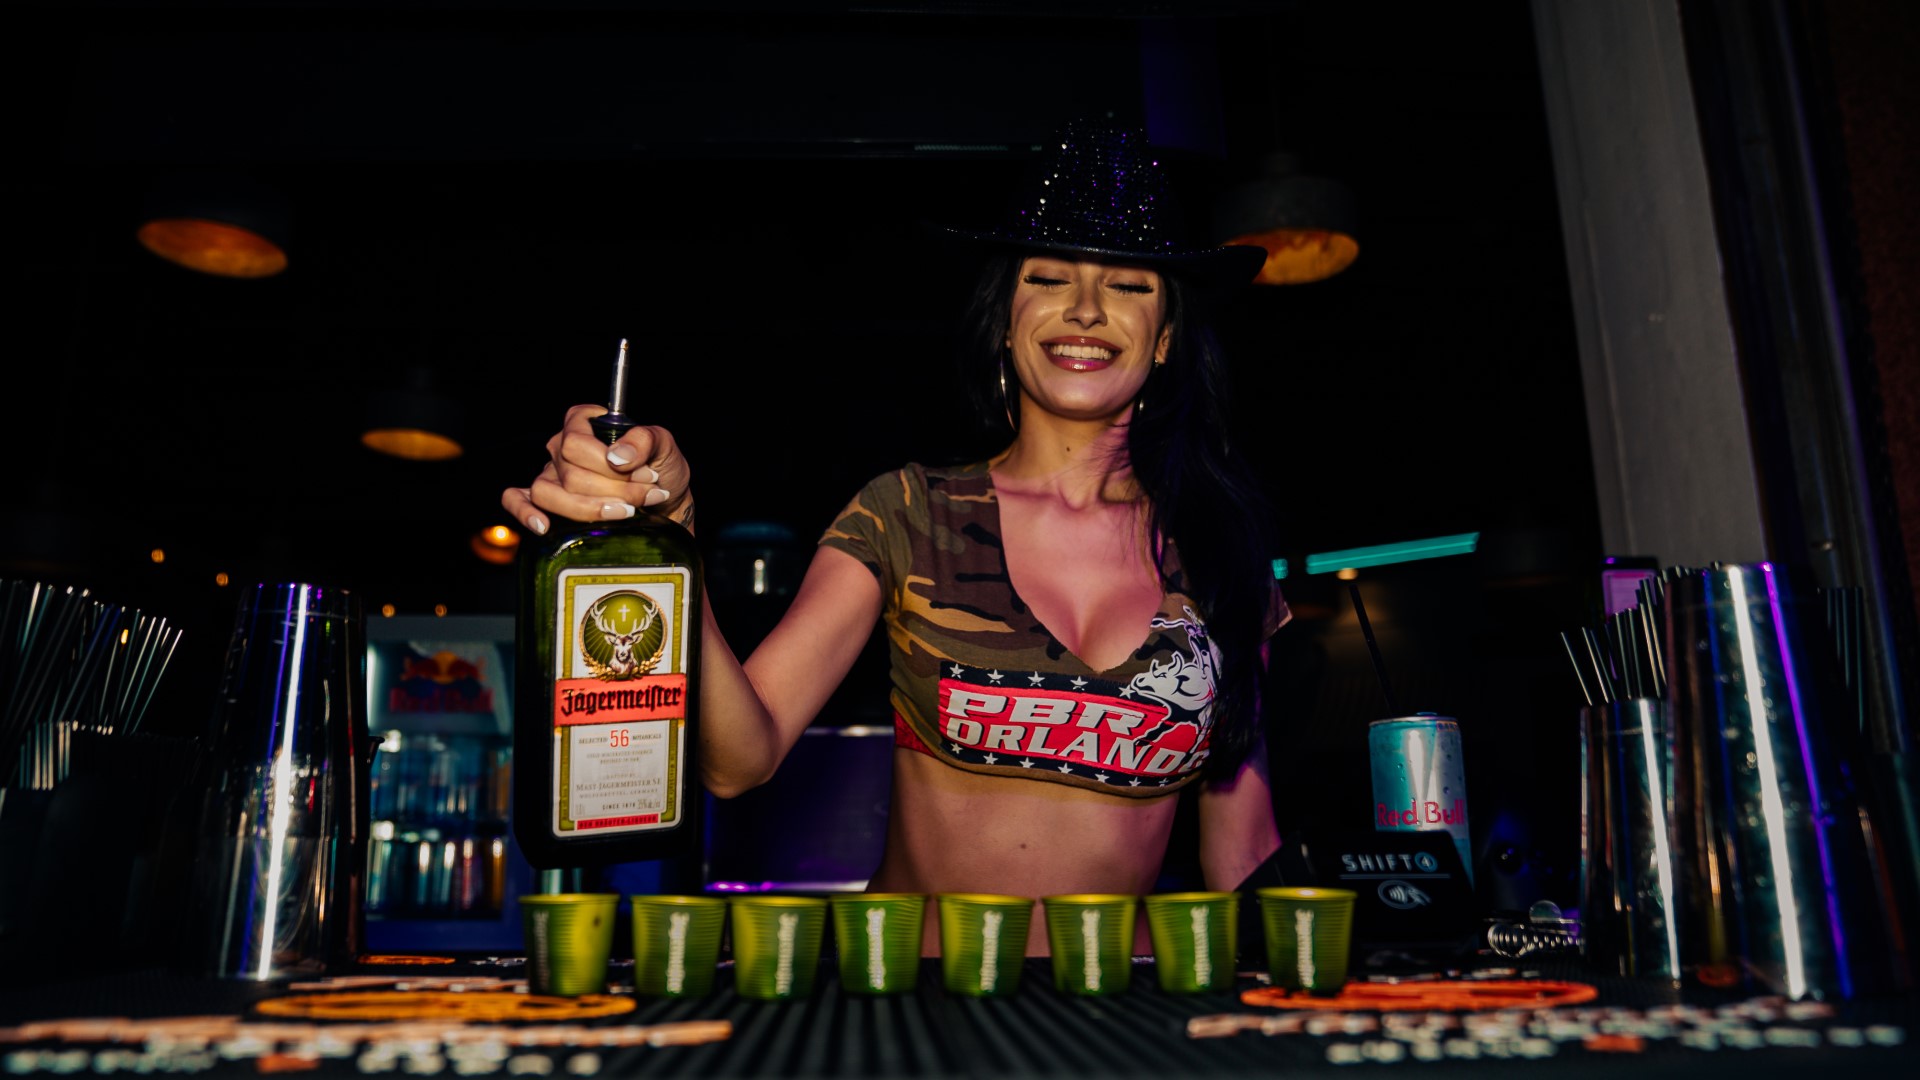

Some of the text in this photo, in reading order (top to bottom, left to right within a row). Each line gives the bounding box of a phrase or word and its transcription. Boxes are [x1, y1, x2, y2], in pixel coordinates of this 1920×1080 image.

[946, 688, 1145, 735] PBR
[610, 729, 629, 747] 56
[1377, 800, 1465, 826] Red Bull
